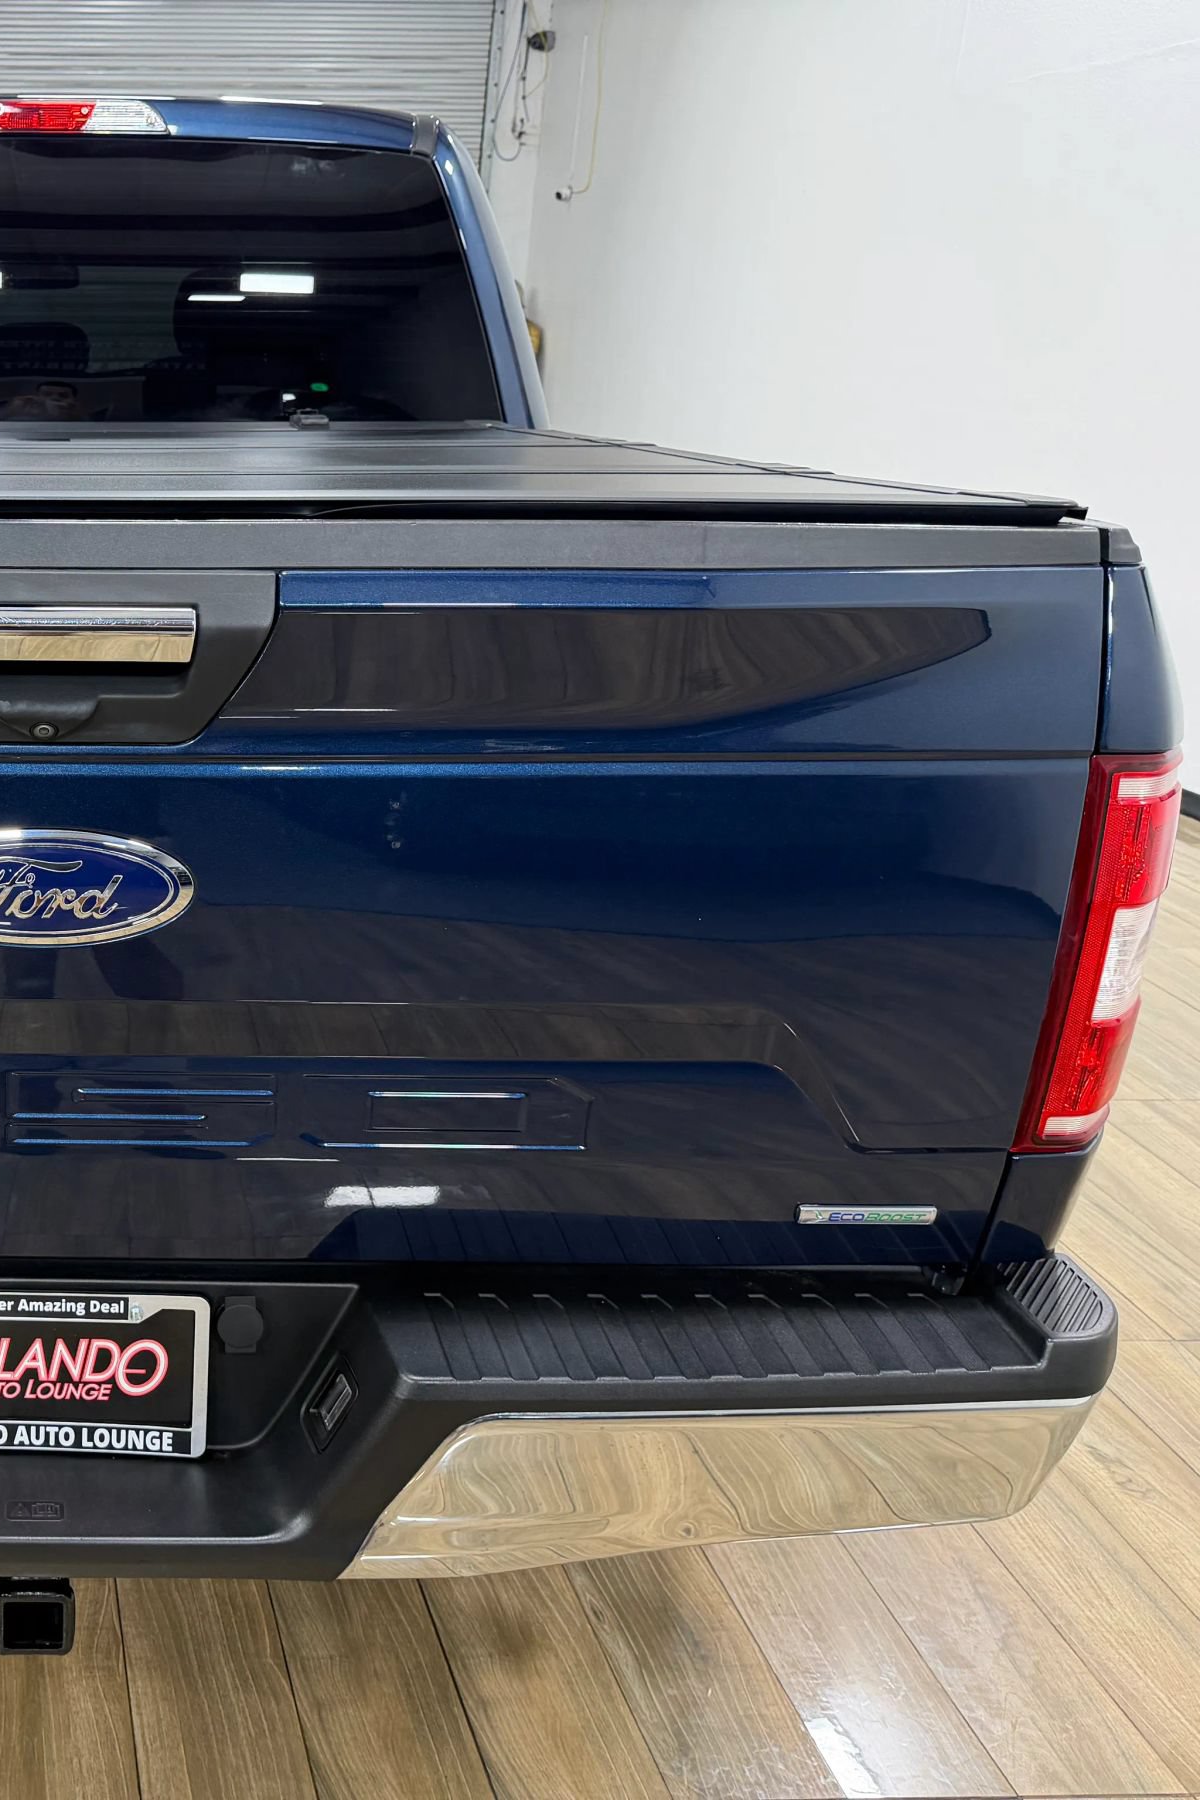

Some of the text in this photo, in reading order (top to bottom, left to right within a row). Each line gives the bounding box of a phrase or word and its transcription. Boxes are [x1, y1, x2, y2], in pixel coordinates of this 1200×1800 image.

[17, 1298, 86, 1316] Amazing
[90, 1299, 124, 1314] Deal
[24, 1379, 113, 1401] LOUNGE
[13, 1425, 76, 1448] AUTO
[81, 1427, 174, 1452] LOUNGE
